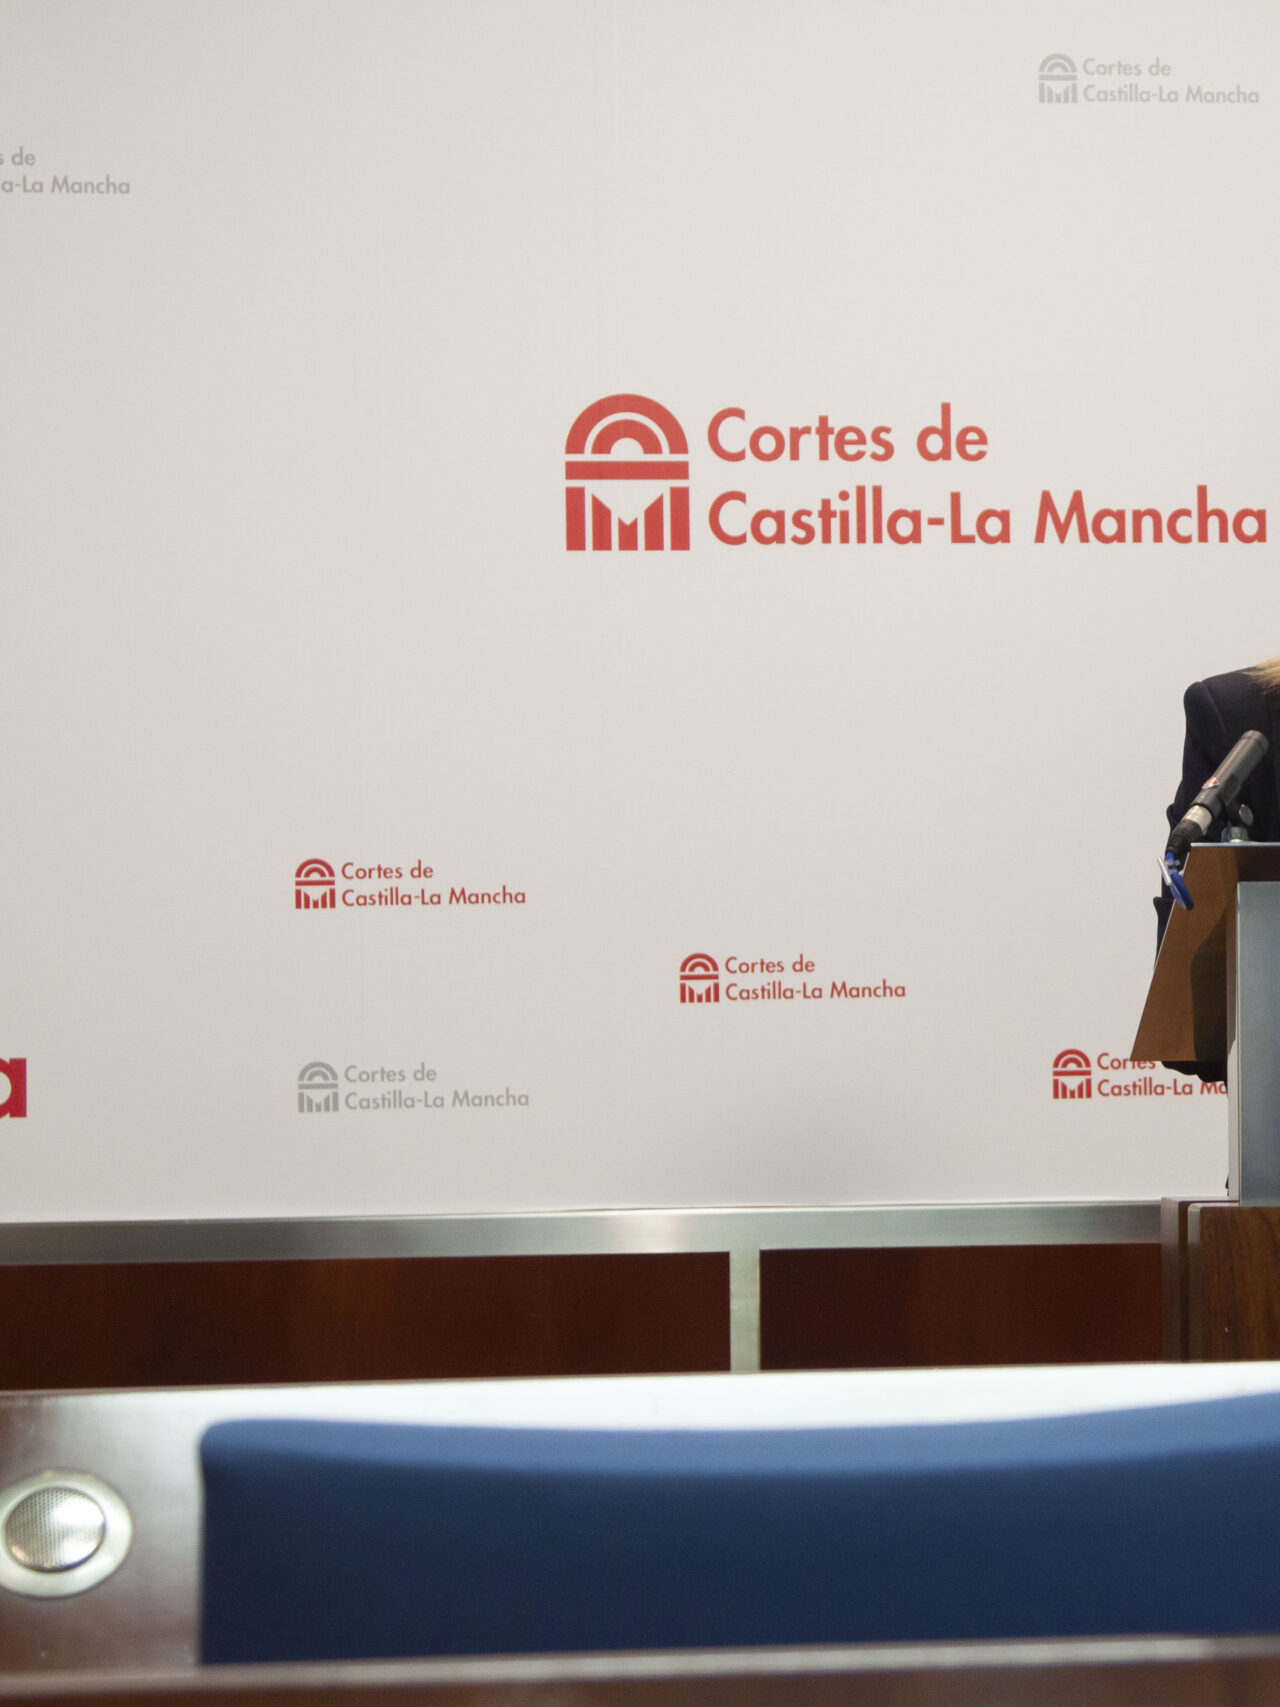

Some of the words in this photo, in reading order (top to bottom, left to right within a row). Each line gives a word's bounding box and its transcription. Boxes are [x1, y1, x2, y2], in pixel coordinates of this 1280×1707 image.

[1083, 58, 1142, 76] Cortes
[1148, 57, 1171, 76] de
[1083, 83, 1178, 102] Castilla-La
[1186, 84, 1259, 103] Mancha
[11, 146, 35, 166] de
[51, 174, 130, 194] Mancha
[708, 407, 894, 462] Cortes
[917, 402, 988, 461] de
[709, 485, 1010, 545] Castilla-La
[1035, 485, 1266, 544] Mancha
[341, 862, 402, 880] Cortes
[410, 860, 433, 878] de
[342, 887, 441, 907] Castilla-La
[449, 885, 525, 904] Mancha
[725, 956, 784, 974] Cortes
[792, 954, 815, 972] de
[725, 981, 822, 1001] Castilla-La
[830, 979, 905, 998] Mancha
[344, 1065, 406, 1083] Cortes
[413, 1062, 436, 1081] de
[1097, 1077, 1193, 1097] Castilla-La
[345, 1090, 444, 1110] Castilla-La
[452, 1087, 529, 1107] Mancha
